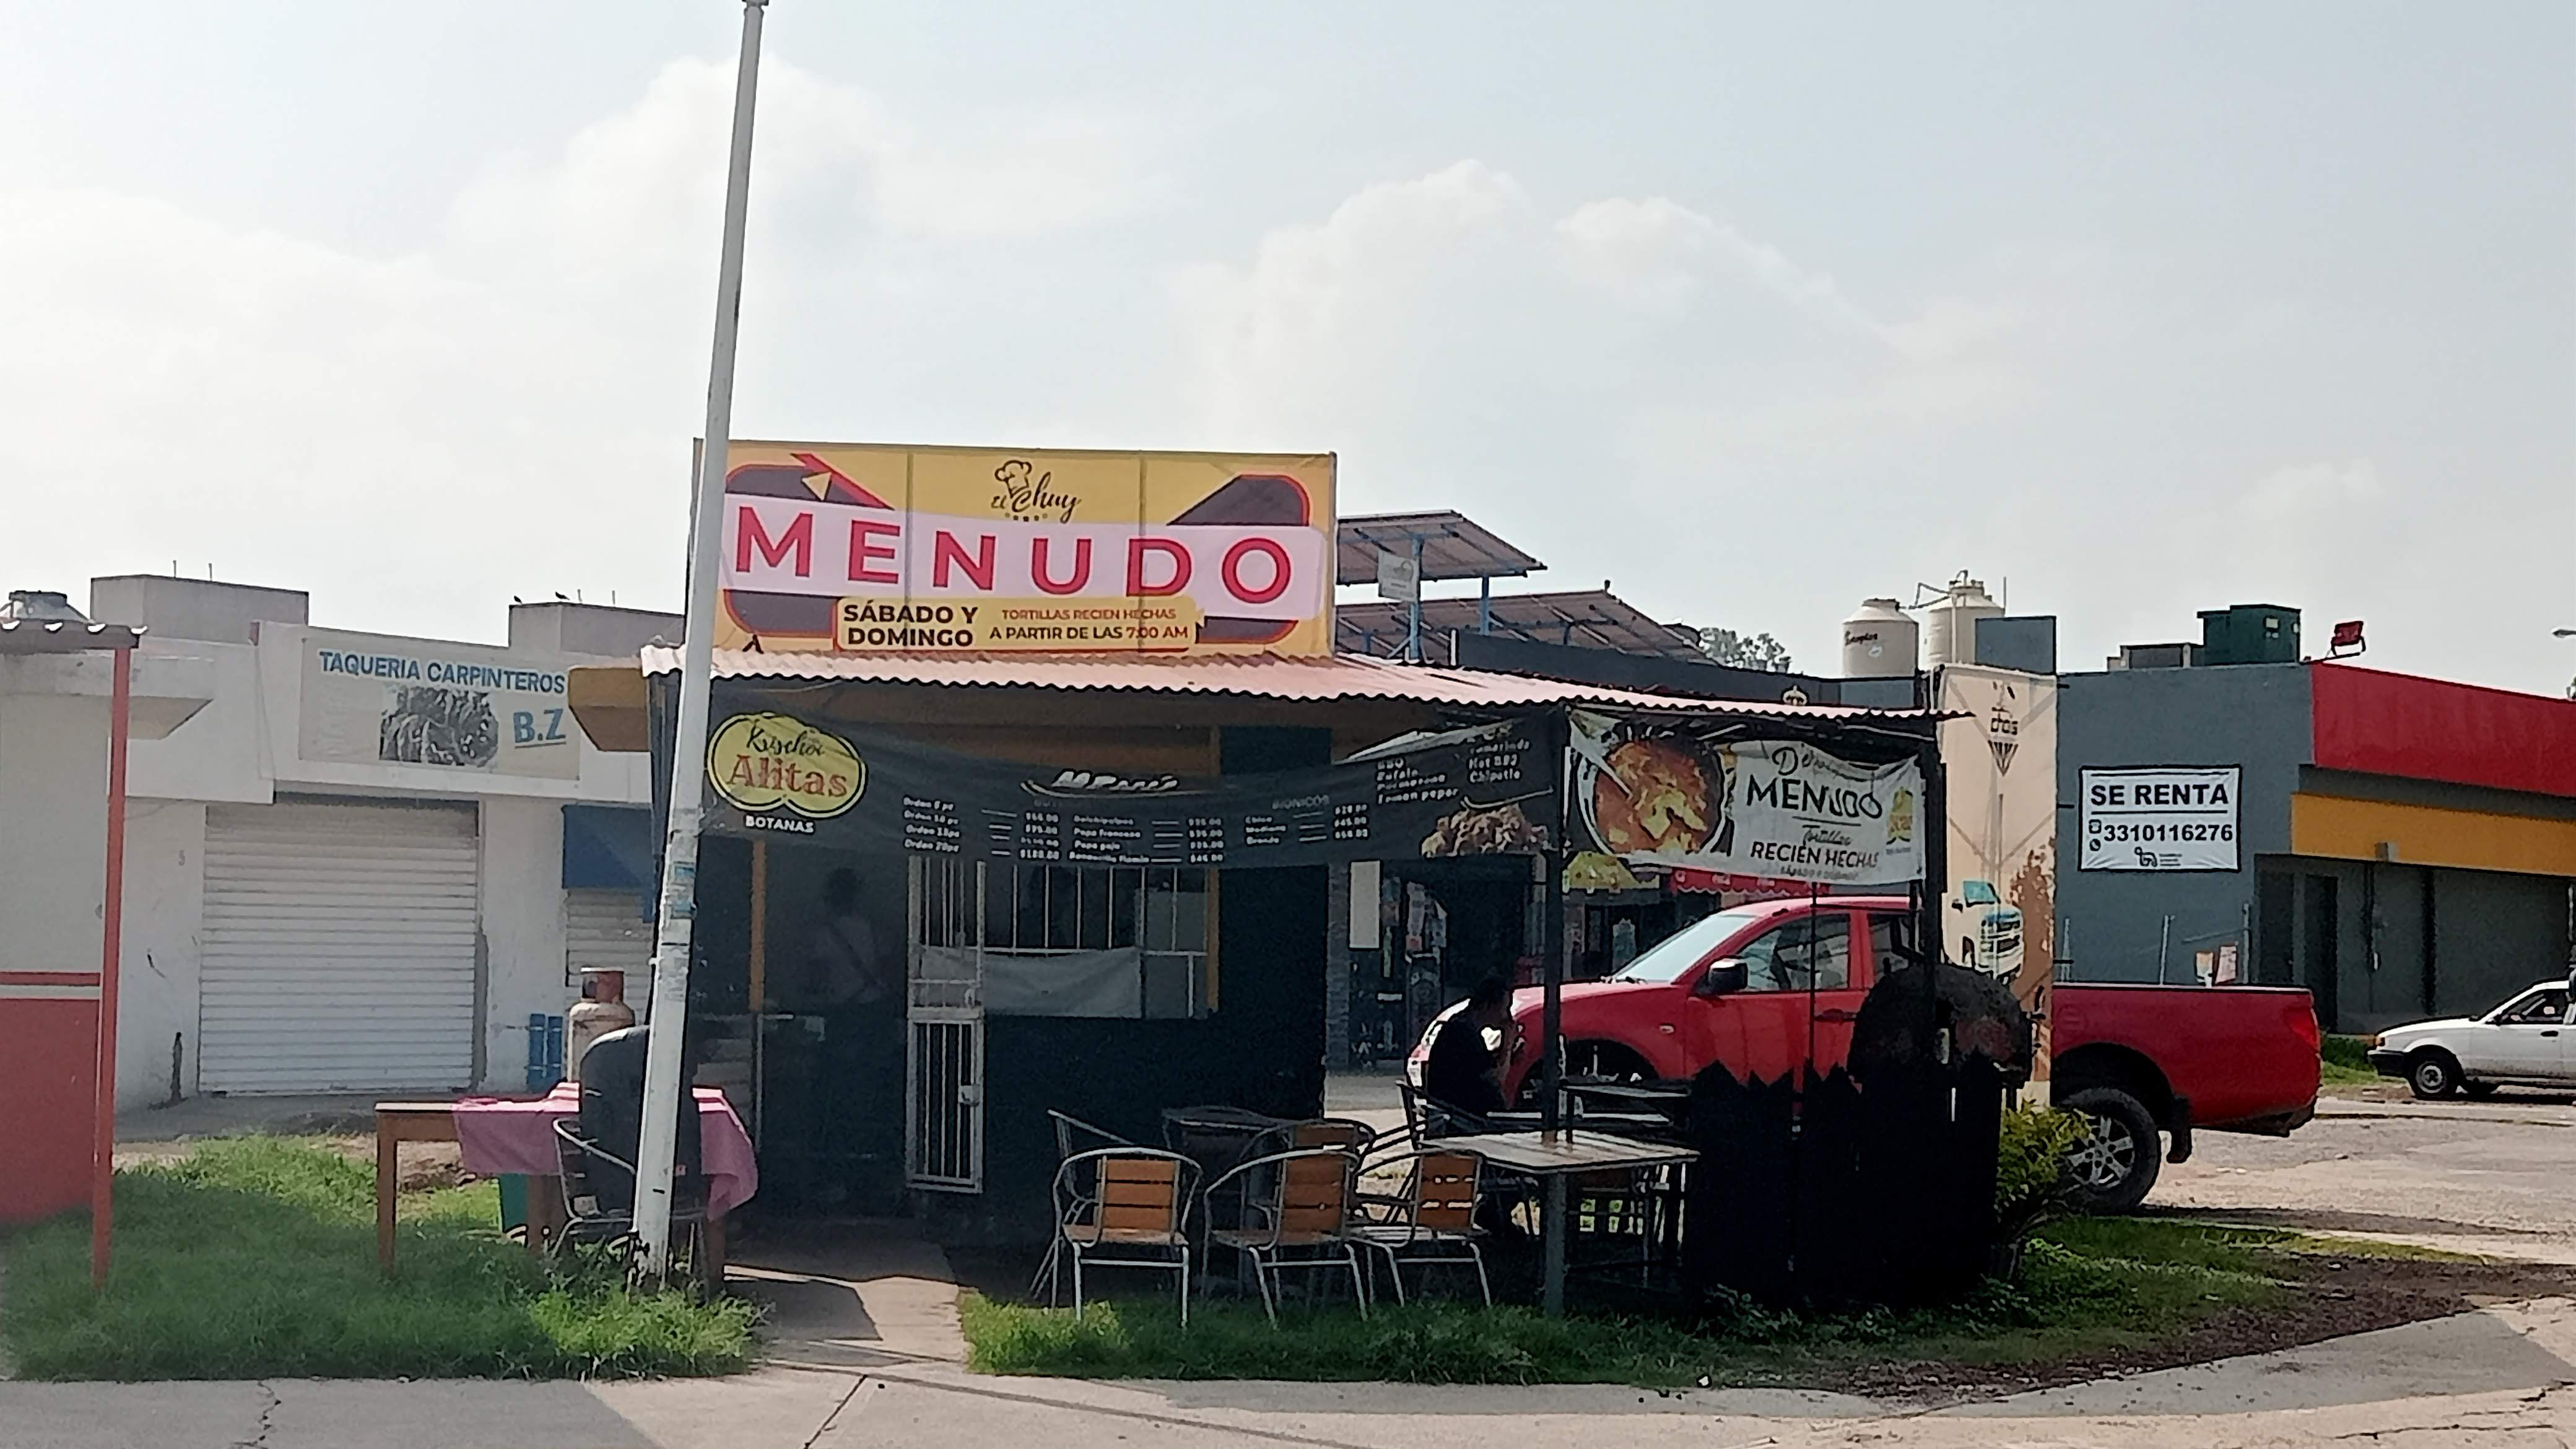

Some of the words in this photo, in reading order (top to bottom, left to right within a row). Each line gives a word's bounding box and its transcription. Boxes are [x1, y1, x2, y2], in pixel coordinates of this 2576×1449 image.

[735, 505, 1292, 605] MENUDO
[843, 599, 954, 624] SÁBADO
[960, 606, 978, 624] Y
[1001, 609, 1071, 620] TORTILLAS
[1073, 609, 1120, 620] RECIEN
[1123, 608, 1177, 620] HECHAS
[848, 627, 973, 648] DOMINGO
[989, 626, 1003, 640] A
[1006, 626, 1063, 640] PARTIR
[1066, 626, 1089, 640] DE
[1092, 626, 1123, 640] LAS
[1125, 625, 1159, 640] 7:00
[1162, 625, 1188, 639] AM
[318, 651, 420, 680] TAQUERIA
[427, 661, 566, 694] CARPINTEROS
[726, 753, 848, 798] Alitas
[2090, 785, 2125, 806] SE
[2134, 783, 2229, 806] RENTA
[745, 814, 815, 834] BOTANAS
[2104, 824, 2233, 842] 3310116276
